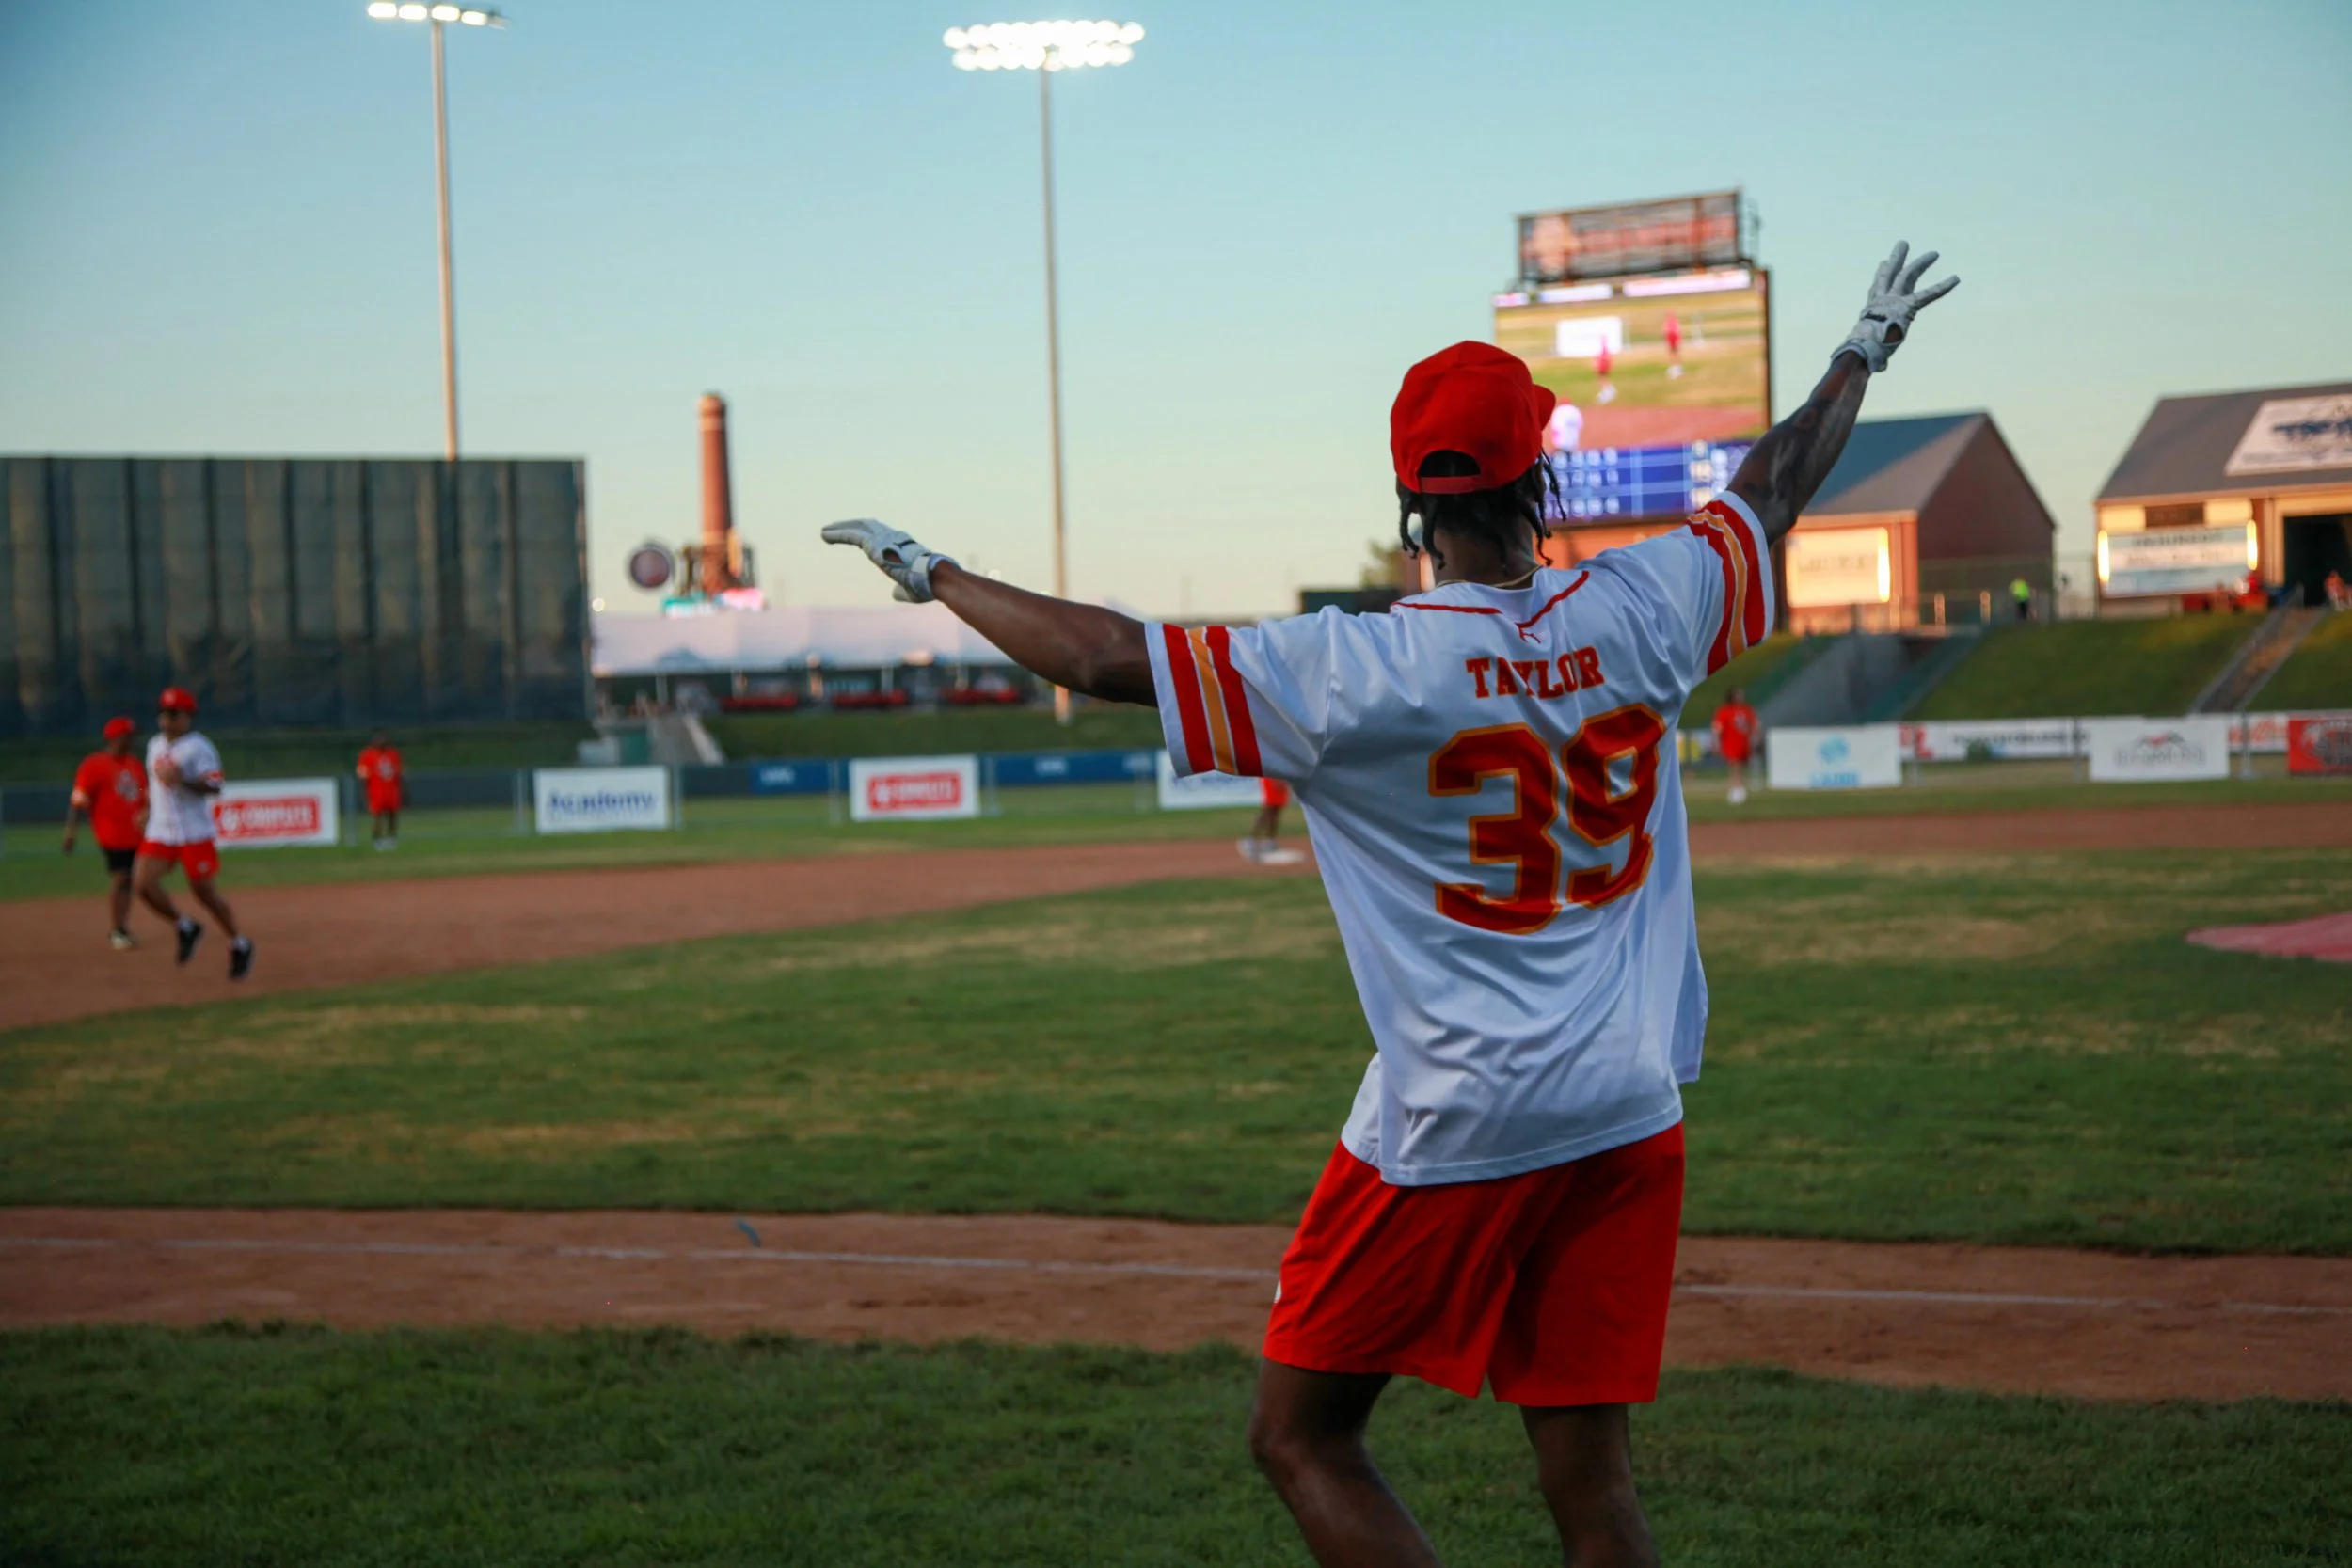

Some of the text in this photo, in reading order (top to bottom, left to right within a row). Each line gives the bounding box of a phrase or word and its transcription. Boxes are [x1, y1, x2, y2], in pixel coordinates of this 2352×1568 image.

[1466, 646, 1605, 700] TAYLOR
[548, 786, 658, 815] Academy
[1427, 703, 1667, 936] 39
